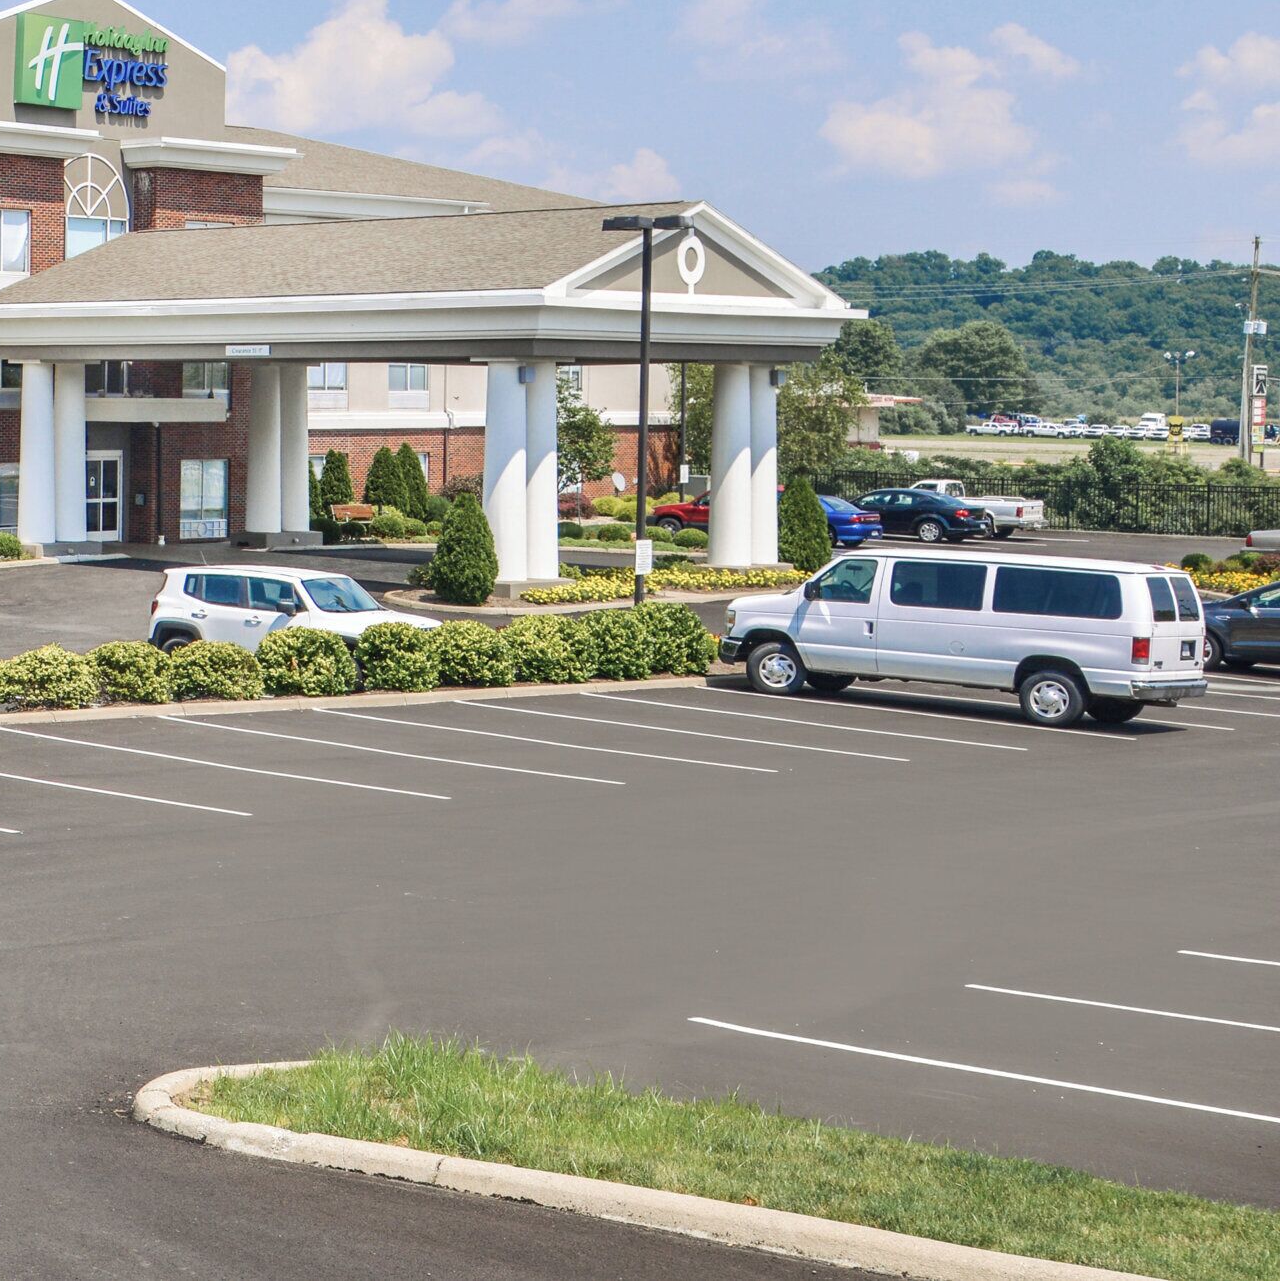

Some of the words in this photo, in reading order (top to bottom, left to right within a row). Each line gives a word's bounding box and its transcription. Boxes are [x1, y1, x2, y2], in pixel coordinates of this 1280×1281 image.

[84, 22, 145, 56] Holiday
[84, 49, 169, 90] Express
[96, 93, 109, 113] &
[109, 94, 153, 117] Suites
